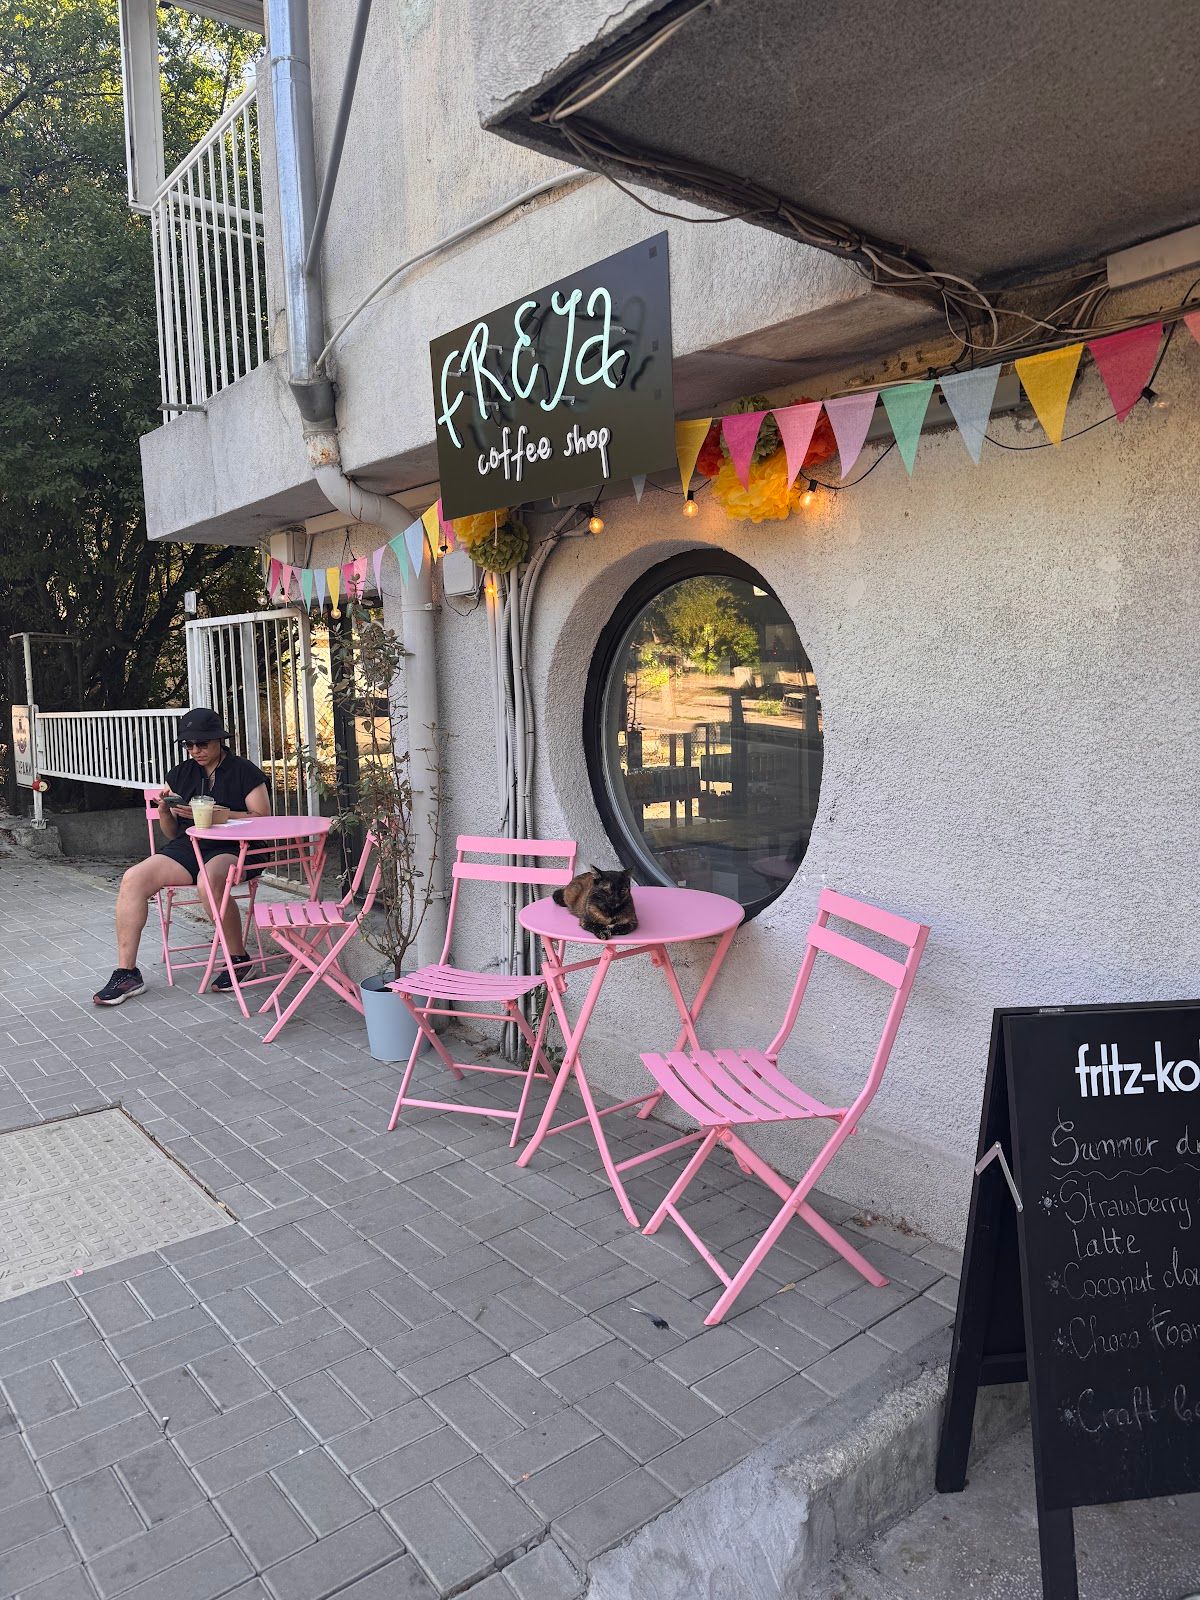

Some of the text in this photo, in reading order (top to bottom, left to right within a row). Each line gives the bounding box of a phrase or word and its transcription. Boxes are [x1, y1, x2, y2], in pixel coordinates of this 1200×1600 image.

[478, 424, 611, 481] coffee shop
[1075, 1039, 1200, 1097] fritz-ko
[1051, 1107, 1159, 1166] Summer
[1060, 1179, 1192, 1230] Strawberry
[1062, 1261, 1156, 1301] Coconut
[1069, 1314, 1142, 1360] Choco
[1077, 1385, 1158, 1432] Craft
